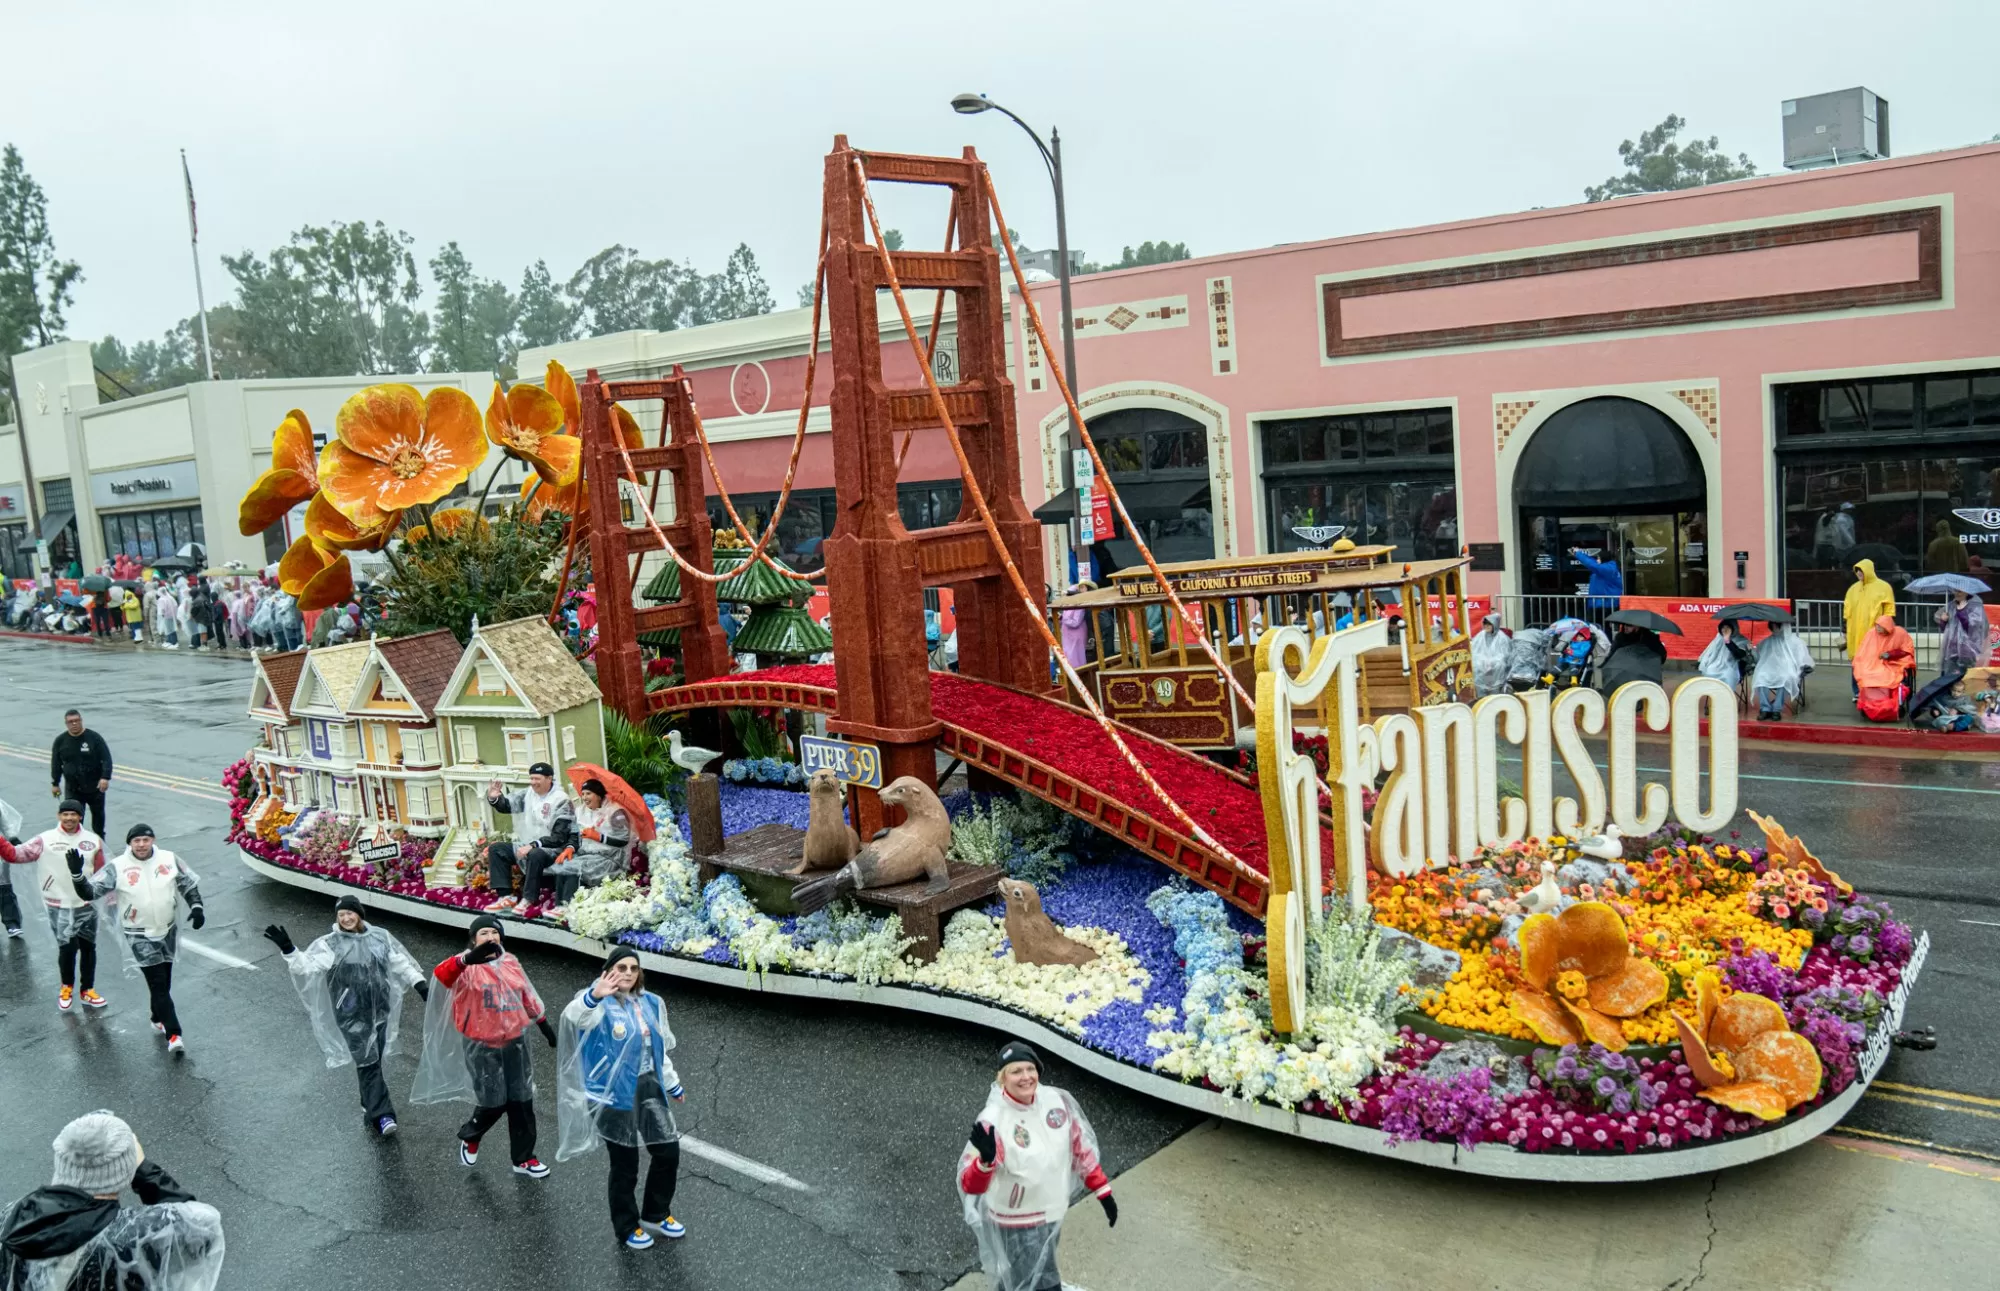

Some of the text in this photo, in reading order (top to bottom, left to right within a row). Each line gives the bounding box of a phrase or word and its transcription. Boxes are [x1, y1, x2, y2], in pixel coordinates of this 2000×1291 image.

[1078, 460, 1088, 468] PAY
[1077, 469, 1090, 477] HERE
[1959, 534, 2000, 544] BENT
[1122, 584, 1138, 595] VAN
[1140, 582, 1158, 594] NESS
[1180, 577, 1228, 591] CALIFORNIA
[1230, 577, 1237, 588] &
[1240, 574, 1274, 587] MARKET
[1277, 571, 1312, 585] STREETS
[1679, 604, 1700, 612] ADA
[1157, 680, 1172, 698] 49
[804, 743, 876, 784] PIER 39
[360, 841, 372, 852] SAN
[364, 846, 397, 860] FRANCISCO
[1858, 1021, 1890, 1084] Believe
[1900, 930, 1931, 997] Francisco
